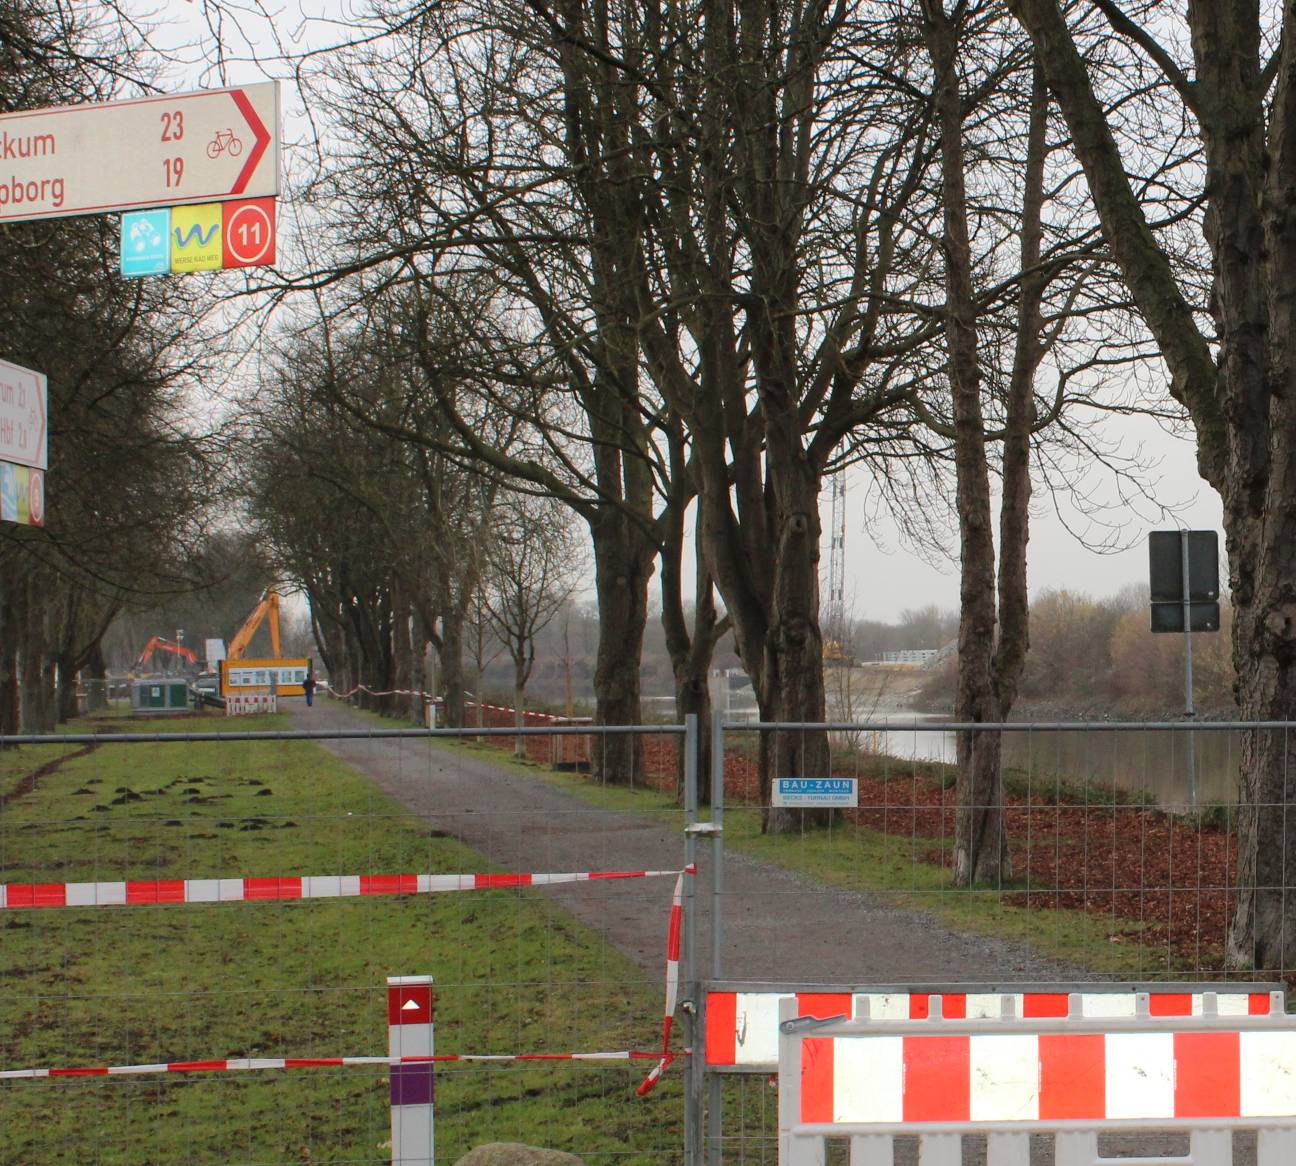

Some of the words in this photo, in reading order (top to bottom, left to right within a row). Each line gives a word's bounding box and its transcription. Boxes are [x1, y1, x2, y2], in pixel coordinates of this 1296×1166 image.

[0, 131, 56, 159] kum
[160, 111, 184, 142] 23
[162, 157, 184, 187] 19
[237, 222, 262, 246] 11
